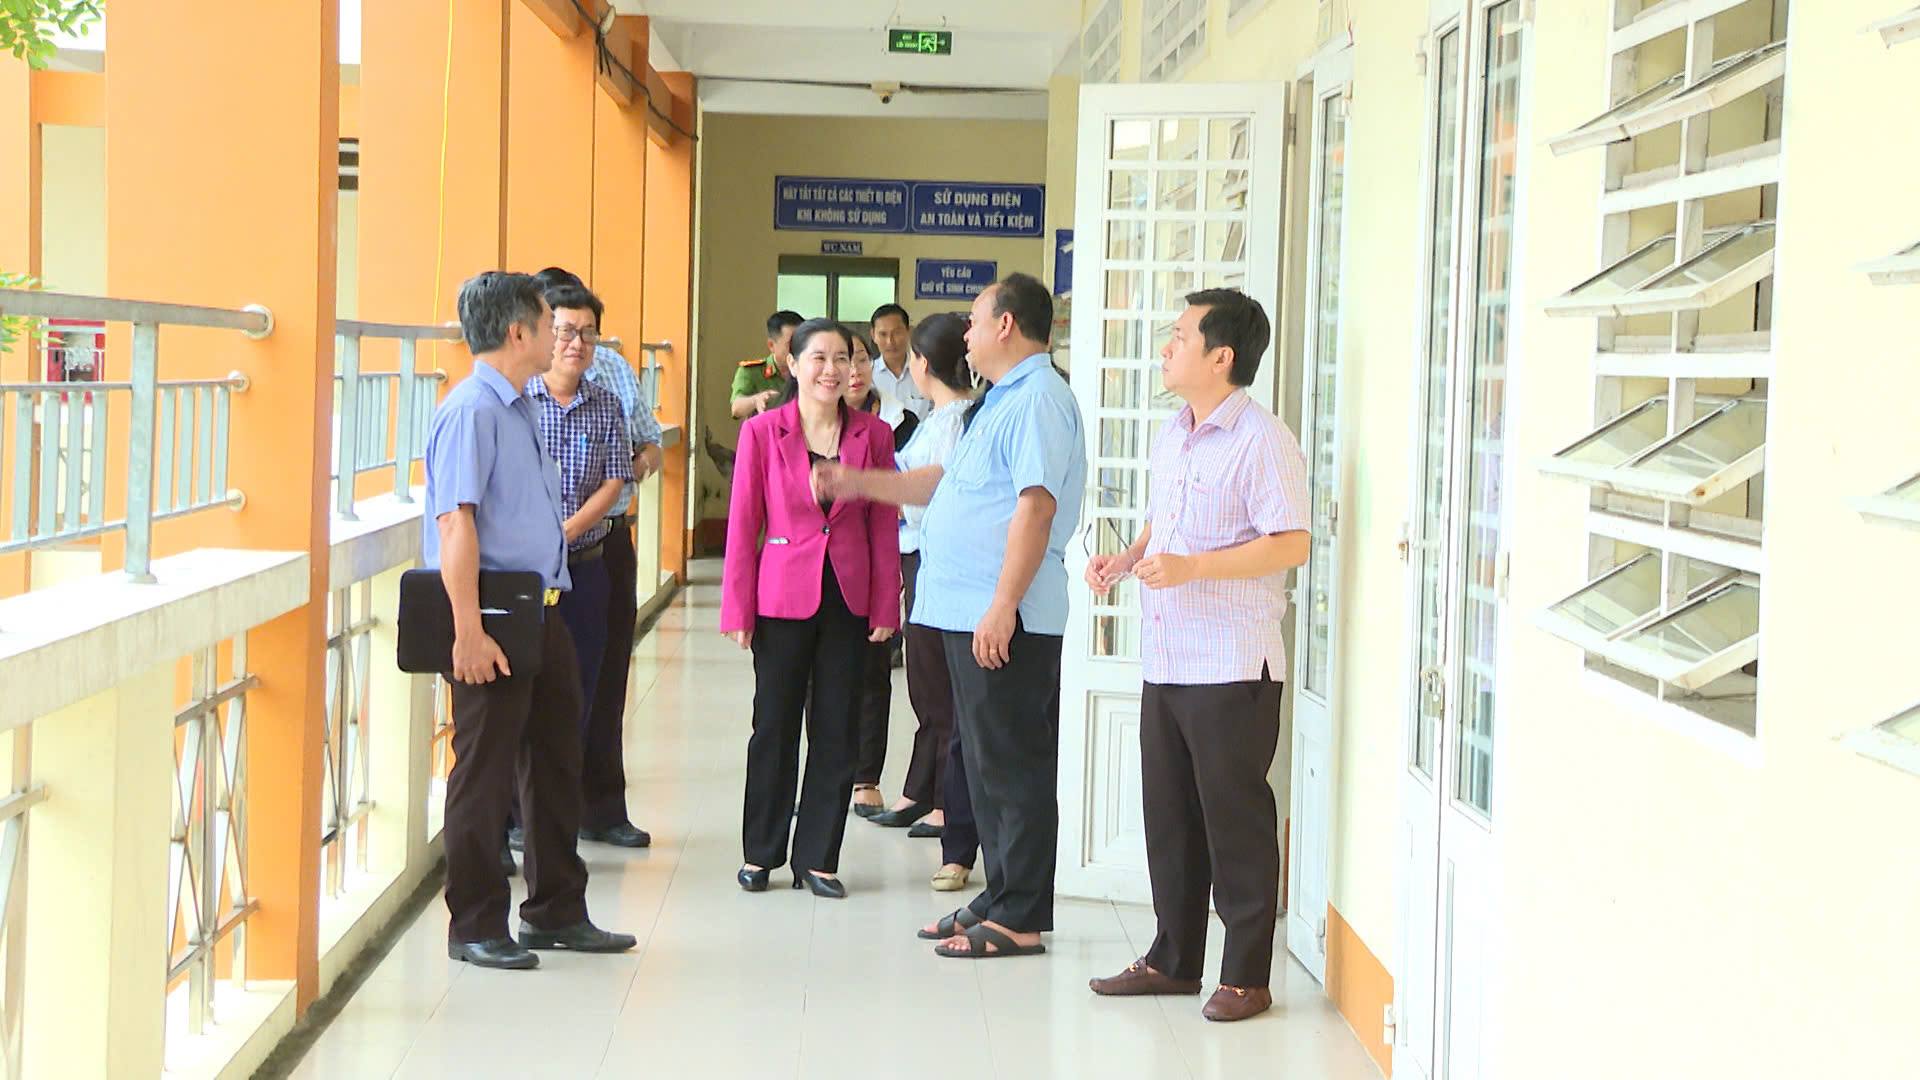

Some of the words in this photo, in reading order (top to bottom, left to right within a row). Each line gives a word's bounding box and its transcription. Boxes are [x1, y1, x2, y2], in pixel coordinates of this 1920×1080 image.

[934, 188, 952, 204] SỬ
[954, 192, 988, 208] DỤNG
[991, 192, 1021, 209] ĐIỆN
[797, 208, 812, 222] KHI
[814, 208, 845, 223] KHÔNG
[862, 210, 886, 225] DỤNG
[920, 213, 935, 226] AN
[938, 211, 965, 226] TOÀN
[967, 212, 981, 227] VÀ
[983, 211, 1004, 228] TIẾT
[1007, 213, 1033, 230] KIỆM
